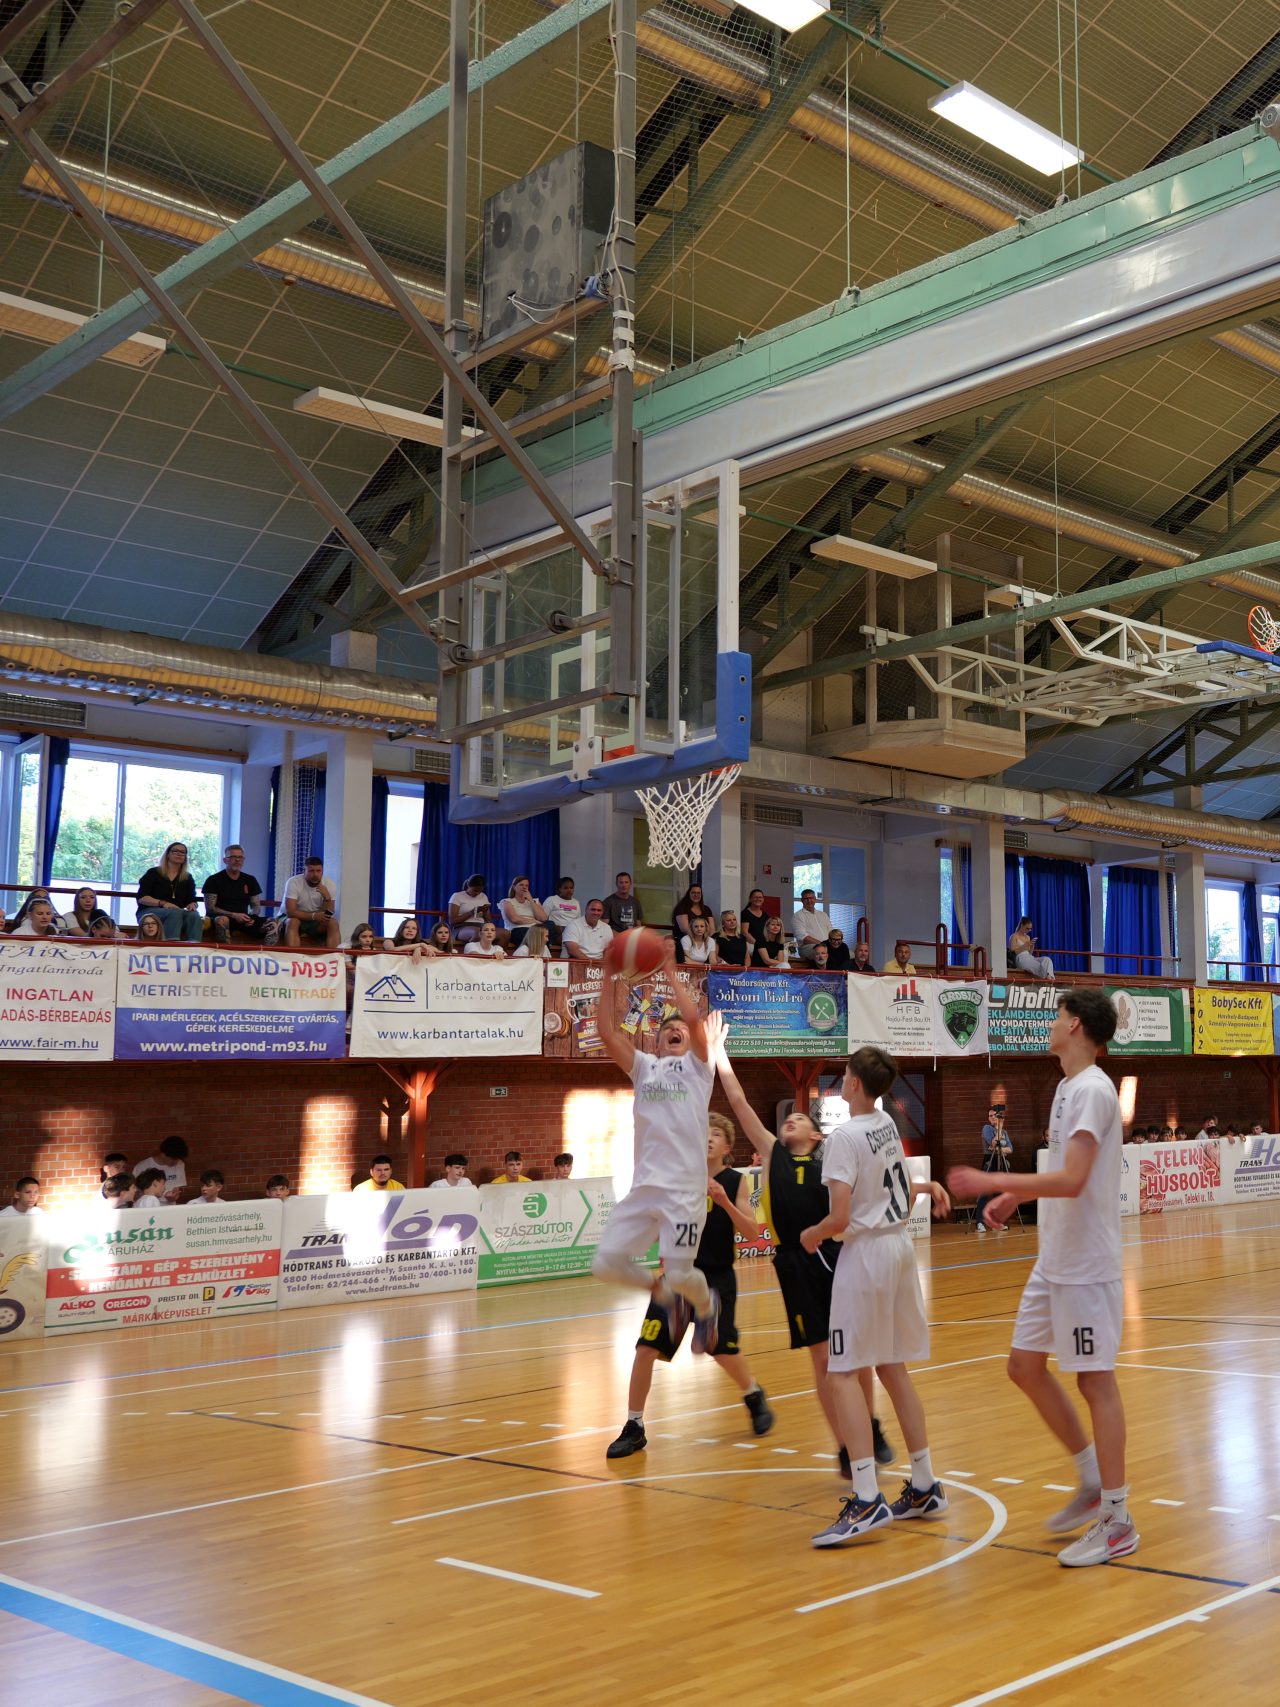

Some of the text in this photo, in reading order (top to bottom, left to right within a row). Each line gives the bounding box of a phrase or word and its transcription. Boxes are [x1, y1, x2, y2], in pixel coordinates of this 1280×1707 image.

[0, 964, 104, 976] Ingatlaniroda
[128, 953, 338, 978] METRIPOND-M93
[435, 978, 535, 992] karbantartaLAK
[728, 978, 777, 989] Vándorsólyom
[6, 988, 94, 1002] INGATLAN
[131, 984, 228, 998] METRISTEEL
[250, 986, 337, 999] METRITRADE
[1212, 995, 1263, 1011] BobySec Kft.
[132, 1011, 339, 1024] IPARI MÉRLEGEK, ACÉLSZERKEZET GYÁRTÁS,
[186, 1023, 295, 1033] GÉPEK KERESKEDELME
[377, 1027, 524, 1040] www.karbantartalak.hu
[140, 1040, 327, 1054] www.metripond-m93.hu
[1153, 1147, 1203, 1169] TELEKI
[1239, 1160, 1262, 1168] TRANS
[795, 1166, 805, 1185] 1
[1147, 1169, 1217, 1195] HÚSBOLT
[1185, 1192, 1201, 1204] Teleki
[186, 1212, 263, 1224] Hódmezővásárhely,
[186, 1227, 217, 1236] Bethlen
[218, 1225, 242, 1233] István
[495, 1220, 573, 1239] SZÁSZBÚTOR
[675, 1222, 698, 1247] 26
[186, 1234, 273, 1249] susan.hmvasarhely.hu
[108, 1244, 155, 1256] ÁRUHÁZ
[153, 1253, 265, 1273] GÉP SZERELVÉNY
[283, 1258, 333, 1273] HÓDTRANS
[386, 1251, 395, 1263] ÉS
[461, 1246, 477, 1255] KFT.
[177, 1268, 247, 1284] SZAKÜZLET
[283, 1275, 307, 1284] 6800
[287, 1267, 473, 1292] Telefon: 62/244-466 Mobil: 30/400-1166
[345, 1282, 420, 1296] www.hodtrans.hu
[59, 1300, 96, 1311] AL-KO
[105, 1298, 149, 1309] OREGON
[122, 1305, 212, 1324] MÁRKAKÉPVISELET
[1072, 1327, 1094, 1355] 16
